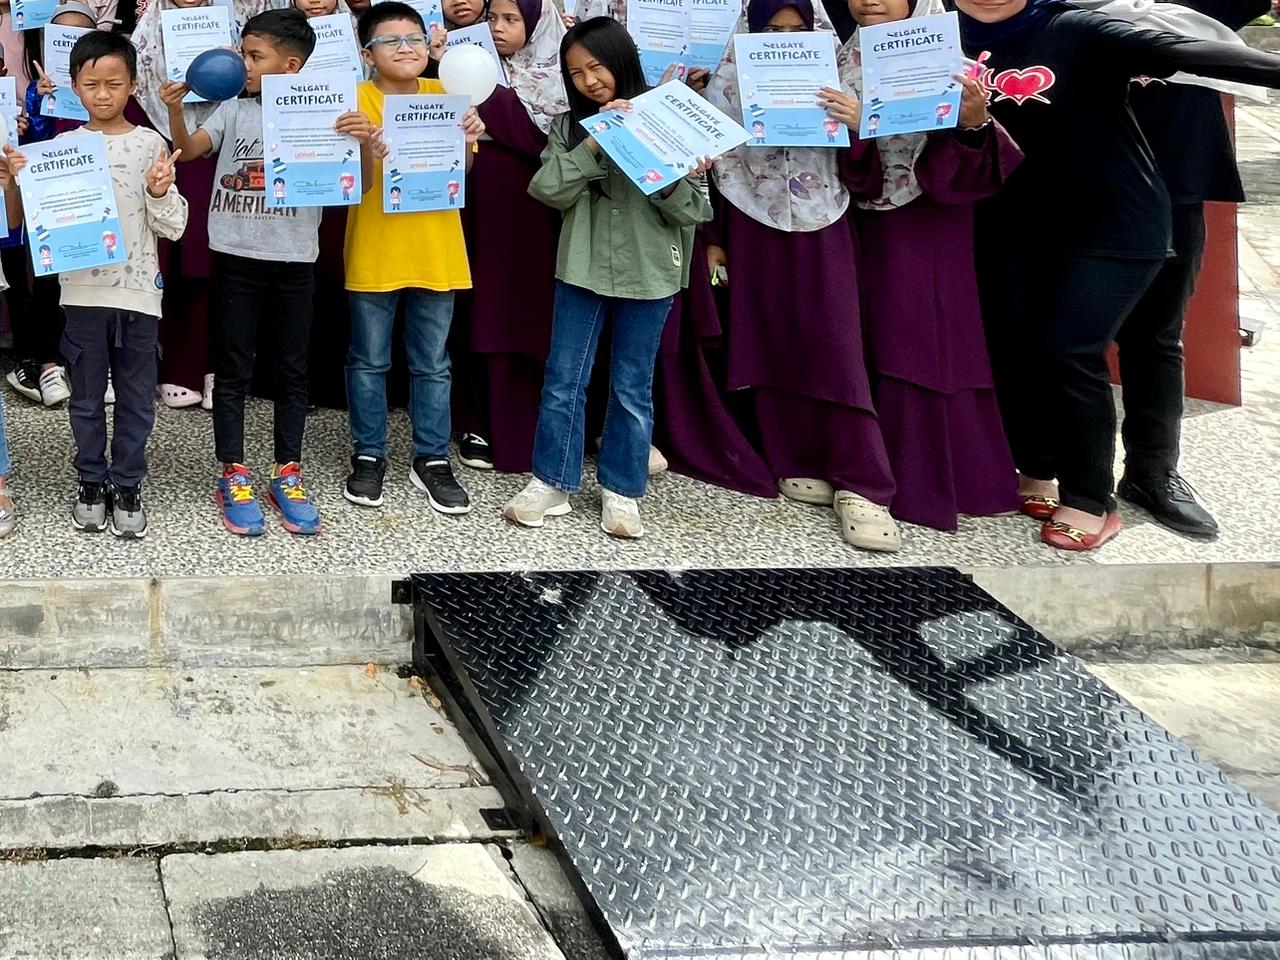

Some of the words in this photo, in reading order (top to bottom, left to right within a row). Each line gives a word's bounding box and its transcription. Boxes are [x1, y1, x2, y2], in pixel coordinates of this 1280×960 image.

[171, 21, 220, 31] CERTIFICATE
[873, 34, 944, 52] CERTIFICATE
[749, 50, 821, 60] CERTIFICATE
[276, 93, 344, 105] CERTIFICATE
[395, 112, 455, 122] CERTIFICATE
[665, 94, 724, 140] CERTIFICATE
[30, 155, 94, 174] CERTIFICATE
